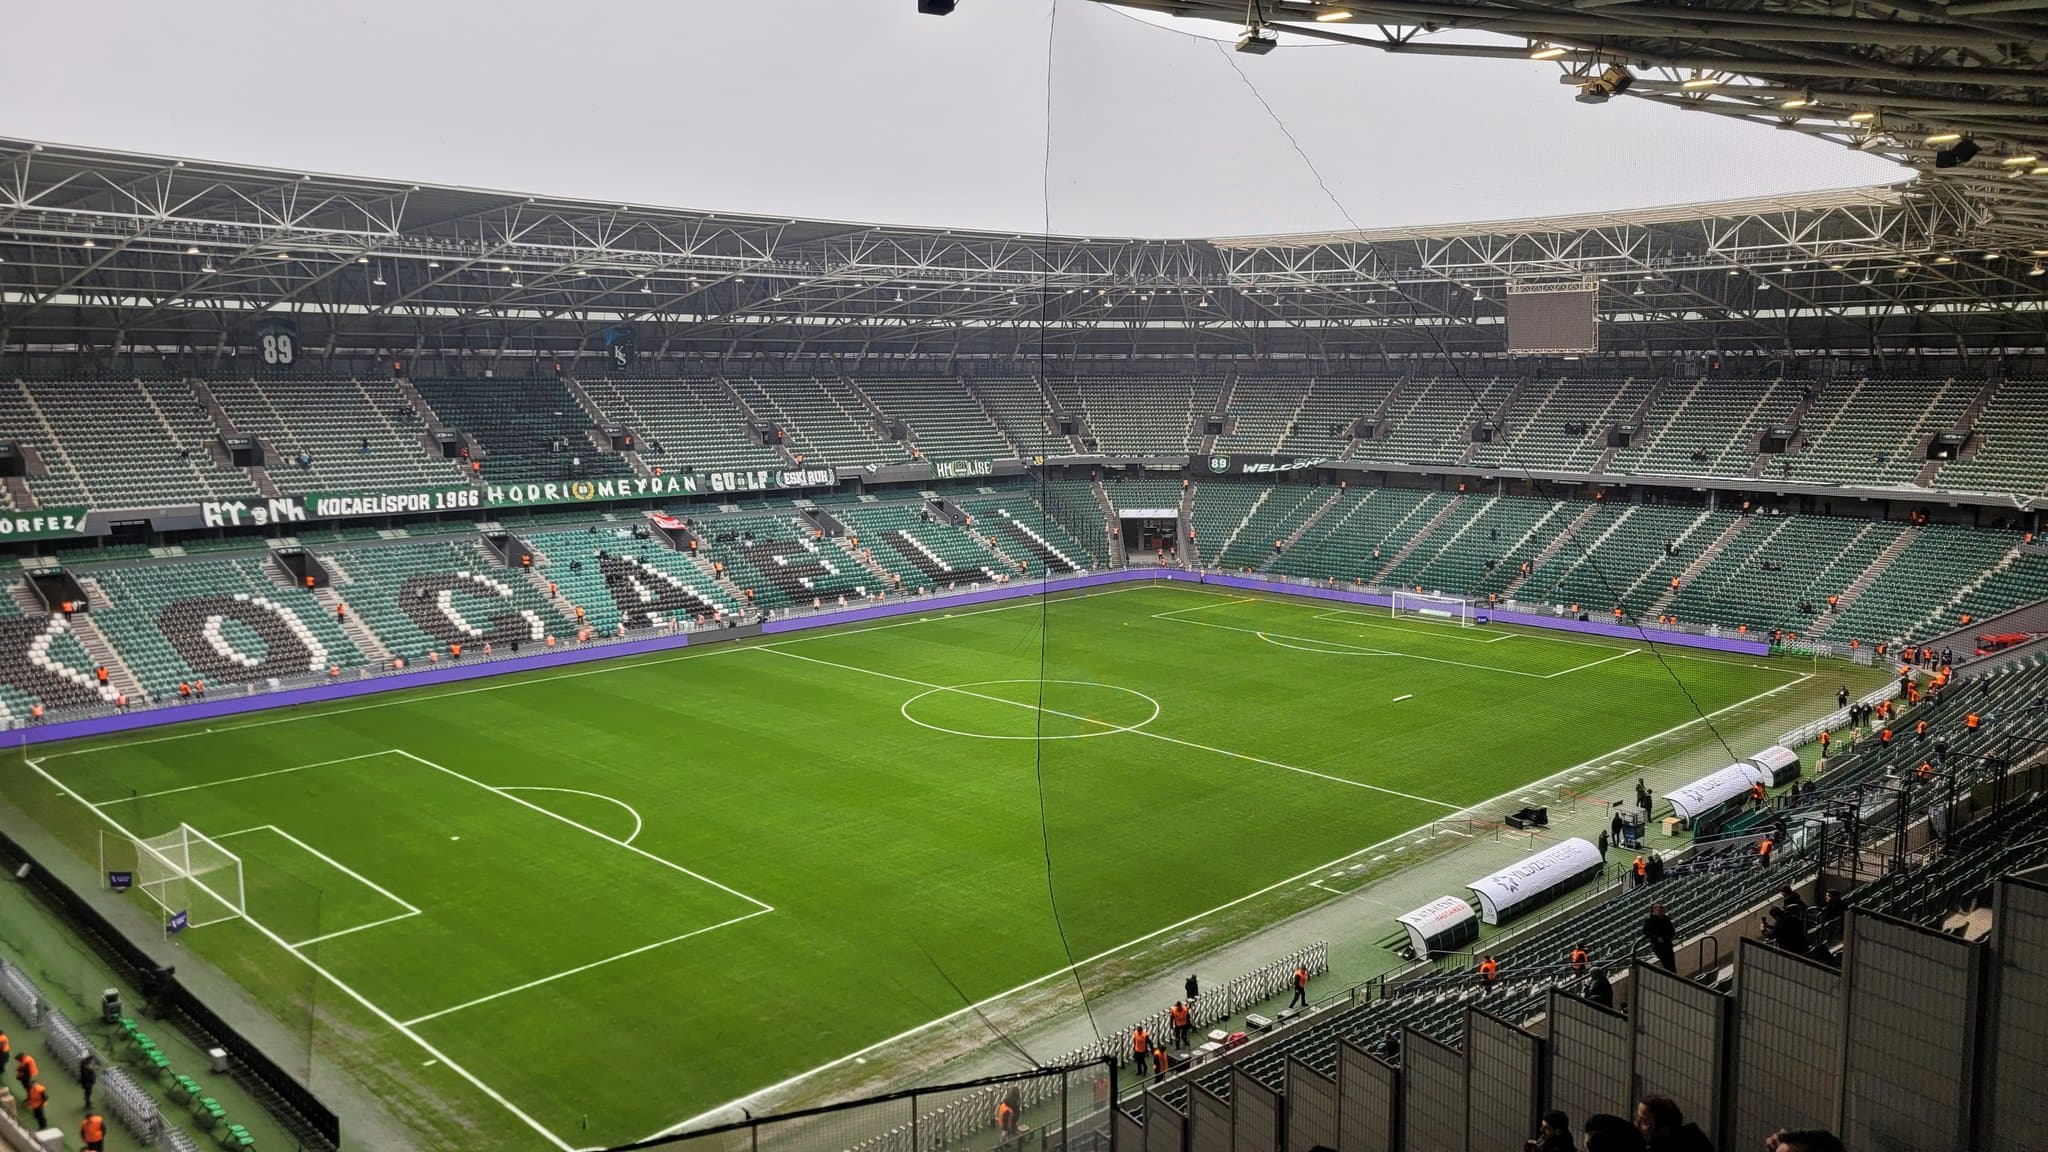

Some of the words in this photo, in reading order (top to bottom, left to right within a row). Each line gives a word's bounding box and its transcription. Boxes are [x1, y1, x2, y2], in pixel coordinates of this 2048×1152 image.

[263, 335, 293, 364] 89
[1211, 458, 1227, 469] 89
[598, 475, 697, 497] MEYDAN
[317, 493, 431, 516] KOCAELİSPOR
[435, 489, 479, 509] 1966
